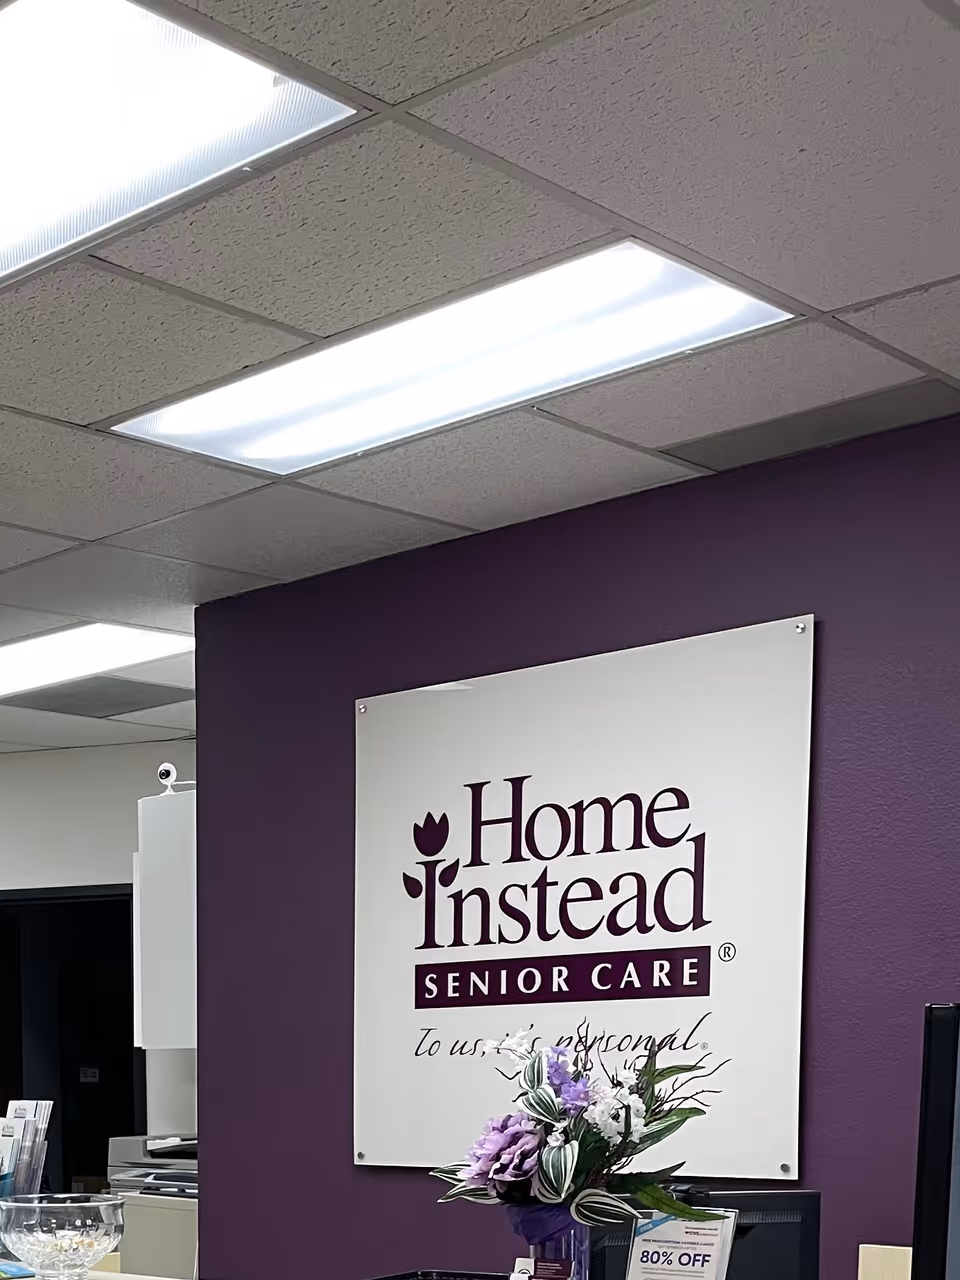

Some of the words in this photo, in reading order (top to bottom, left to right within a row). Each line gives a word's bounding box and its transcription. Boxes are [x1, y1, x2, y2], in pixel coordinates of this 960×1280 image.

[463, 775, 691, 867] Home
[414, 832, 712, 950] Instead
[424, 966, 569, 998] SENIOR
[591, 959, 698, 989] CARE
[415, 1028, 441, 1056] To
[450, 1038, 486, 1058] us,
[496, 1023, 542, 1055] i's
[640, 1250, 673, 1266] 80%
[678, 1252, 711, 1267] OFF
